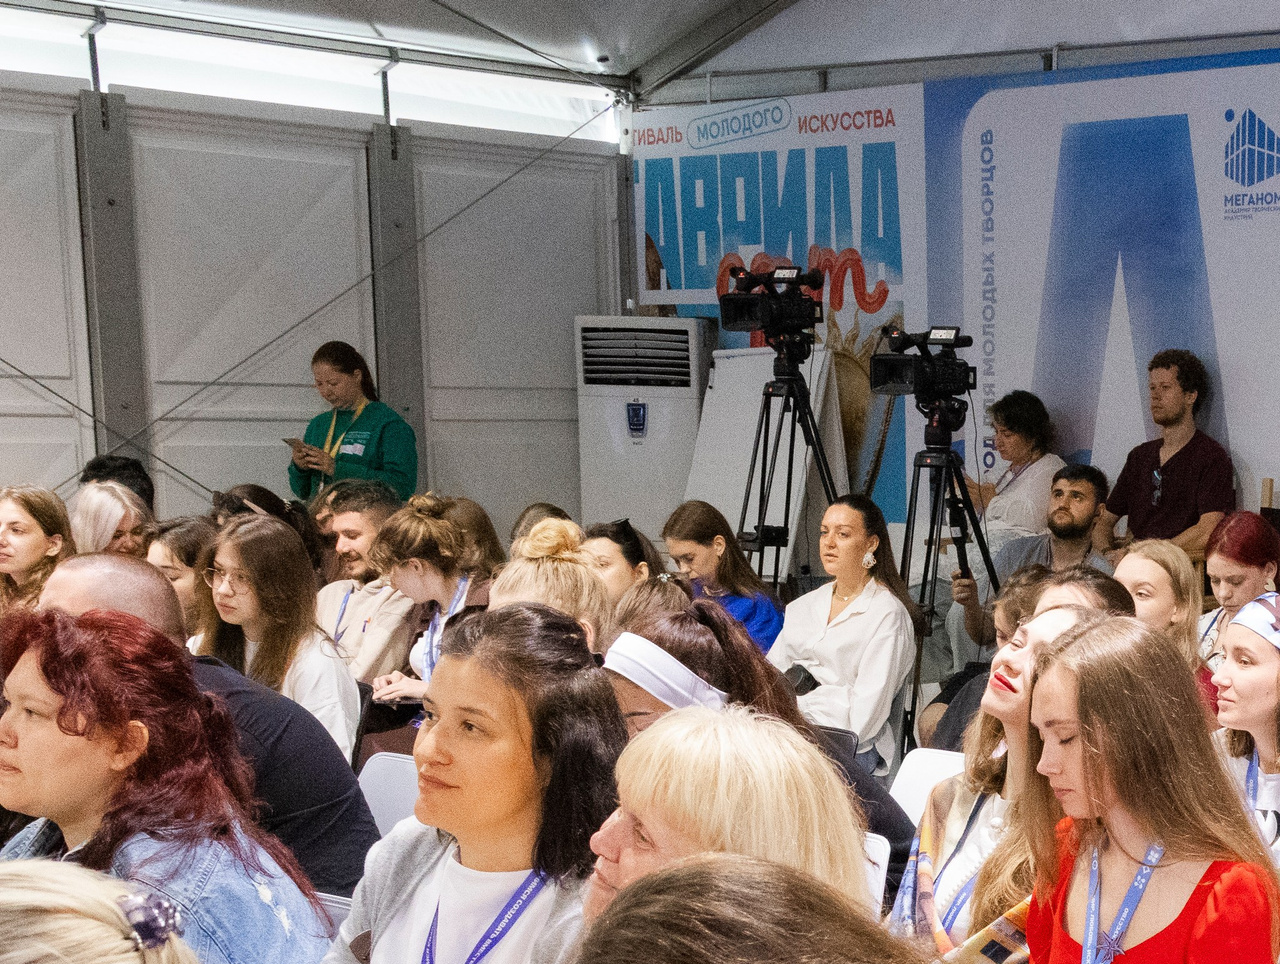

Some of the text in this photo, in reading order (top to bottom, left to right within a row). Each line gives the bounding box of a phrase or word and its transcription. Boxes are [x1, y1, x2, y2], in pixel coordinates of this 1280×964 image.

[696, 105, 784, 141] МОЛОДОГО
[798, 108, 897, 134] ИСКУССТВА
[633, 141, 904, 292] АВРИДА
[980, 129, 996, 244] ТВОРЦОВ
[981, 251, 997, 376] МОЛОДЫХ
[490, 899, 523, 939] СОЗДАВАТЬ
